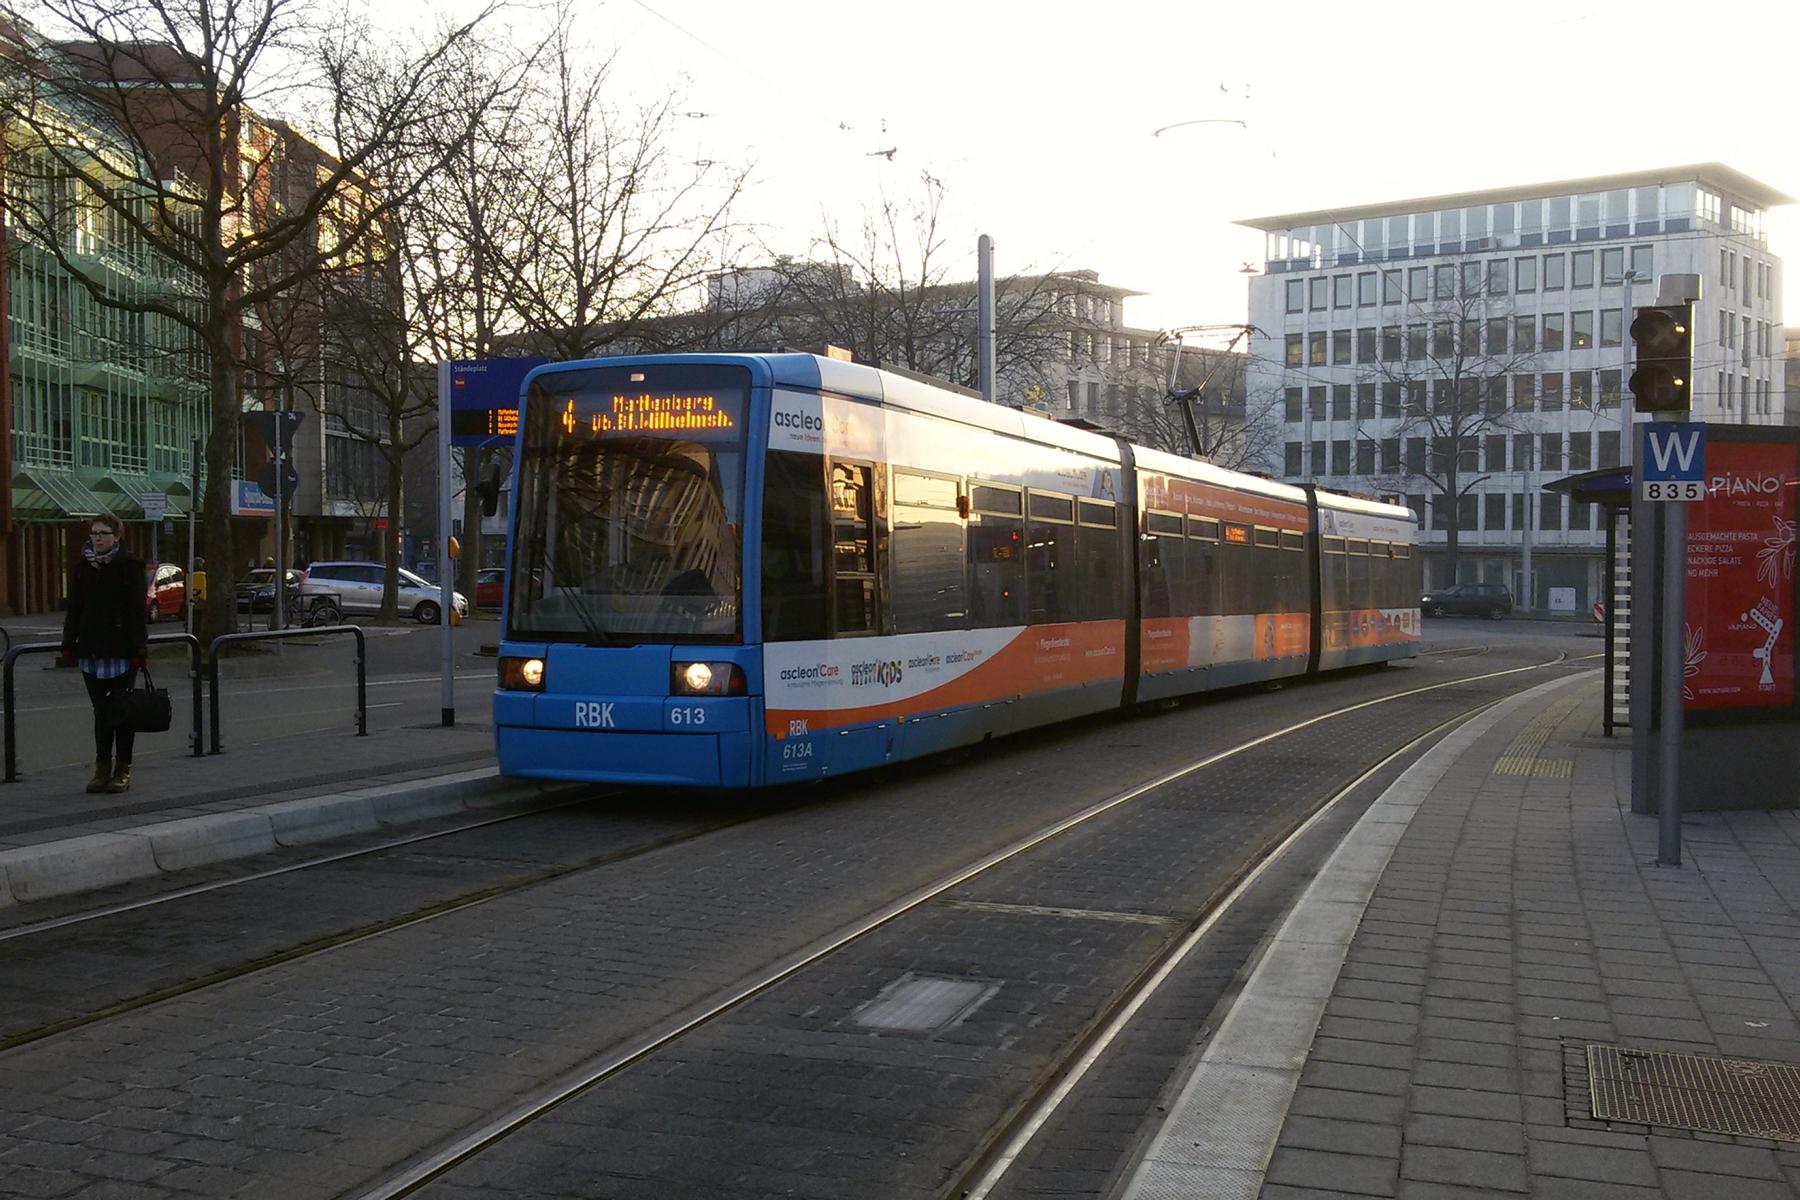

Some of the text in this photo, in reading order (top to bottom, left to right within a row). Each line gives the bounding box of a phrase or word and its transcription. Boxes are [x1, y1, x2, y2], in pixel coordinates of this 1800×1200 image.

[613, 394, 713, 412] Mattenberg
[563, 400, 576, 433] 4
[1649, 431, 1700, 472] W
[1648, 483, 1698, 499] 835
[1704, 472, 1780, 498] PIANO
[1688, 532, 1758, 541] AUSGEMACHTE PASTA
[1687, 544, 1734, 553] ECKERE PIZZA
[1718, 556, 1743, 565] SALATE
[1699, 568, 1719, 577] MEHR
[575, 702, 615, 727] RBK
[670, 708, 705, 725] 613
[789, 719, 808, 737] RBK
[783, 743, 813, 759] 613A
